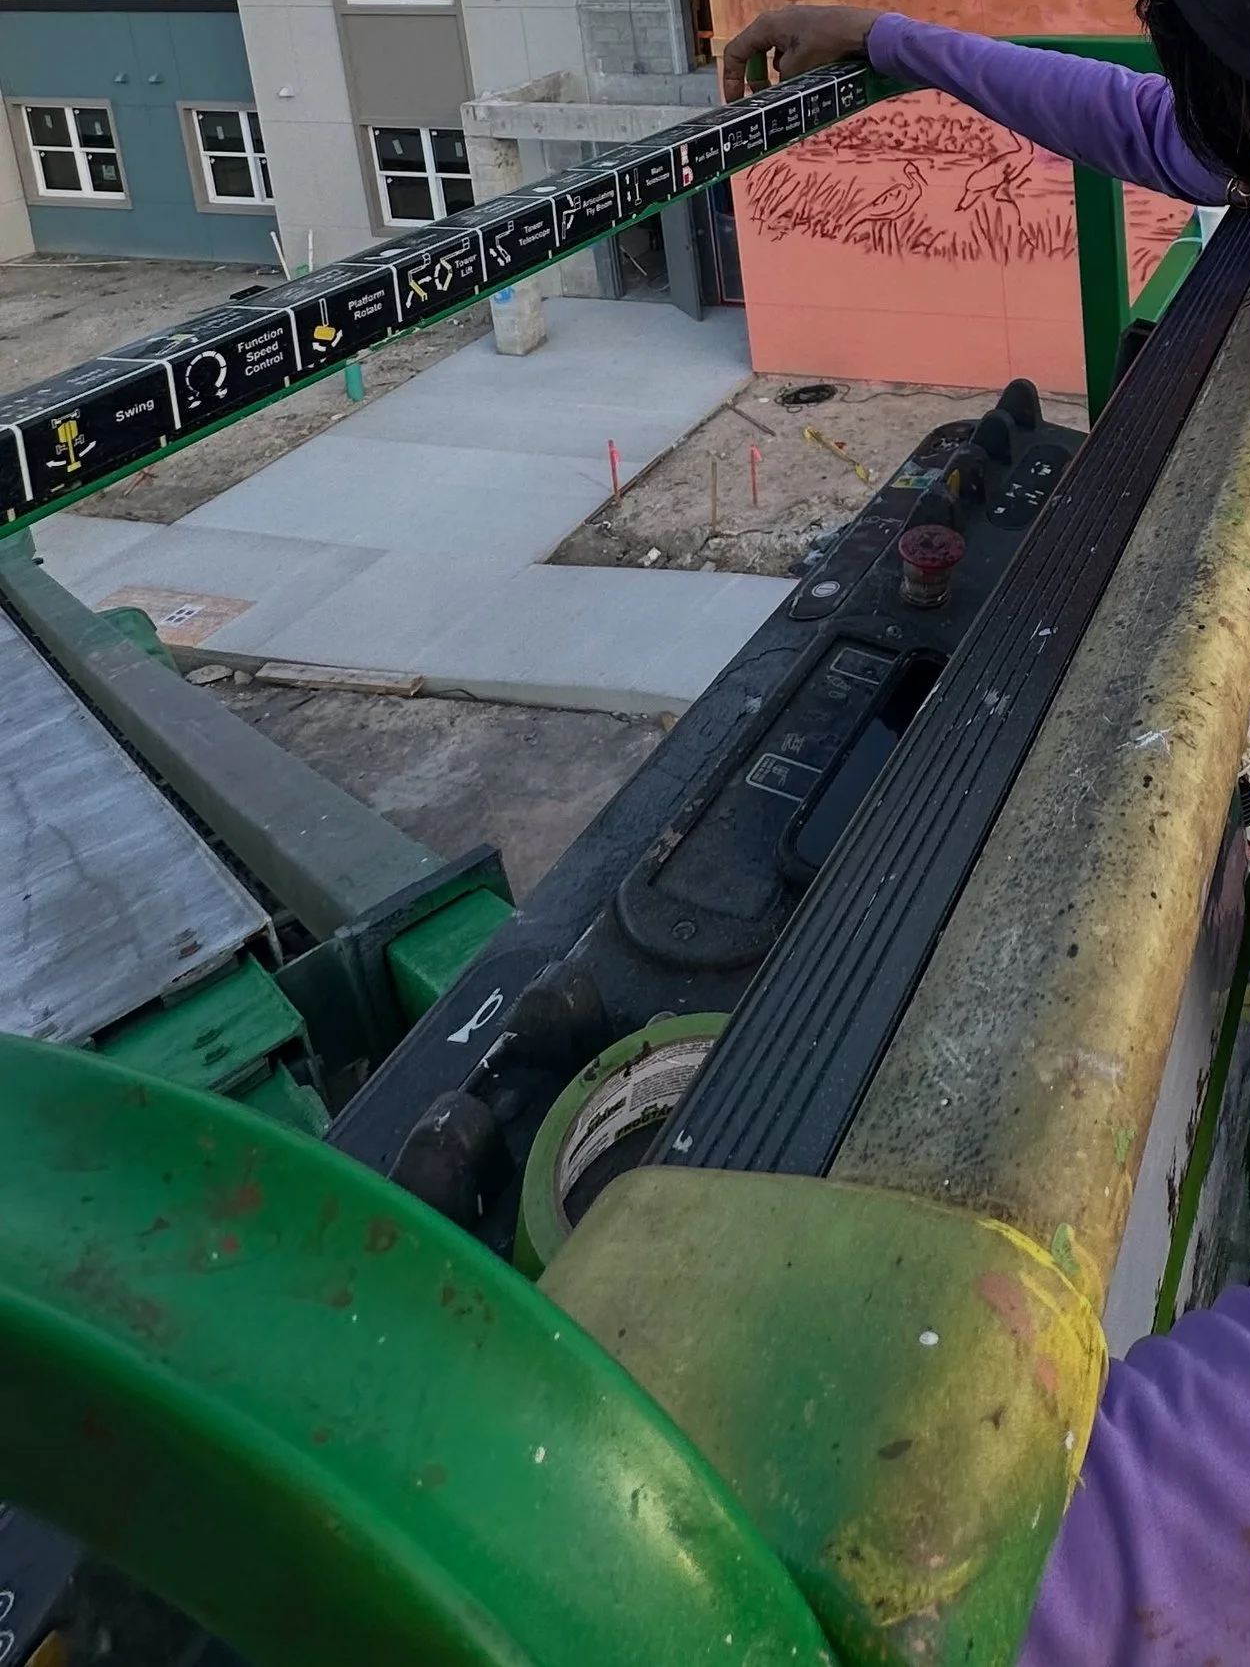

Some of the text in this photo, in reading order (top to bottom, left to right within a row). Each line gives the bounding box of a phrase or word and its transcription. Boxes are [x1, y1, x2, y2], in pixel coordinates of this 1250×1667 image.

[518, 228, 551, 247] Telescope
[523, 220, 545, 234] Tower
[454, 254, 477, 269] Tower
[348, 289, 385, 311] Platform
[353, 302, 383, 321] Rotate
[237, 327, 284, 353] Function
[246, 341, 279, 363] Speed
[244, 351, 284, 376] Control
[115, 398, 155, 423] Swing
